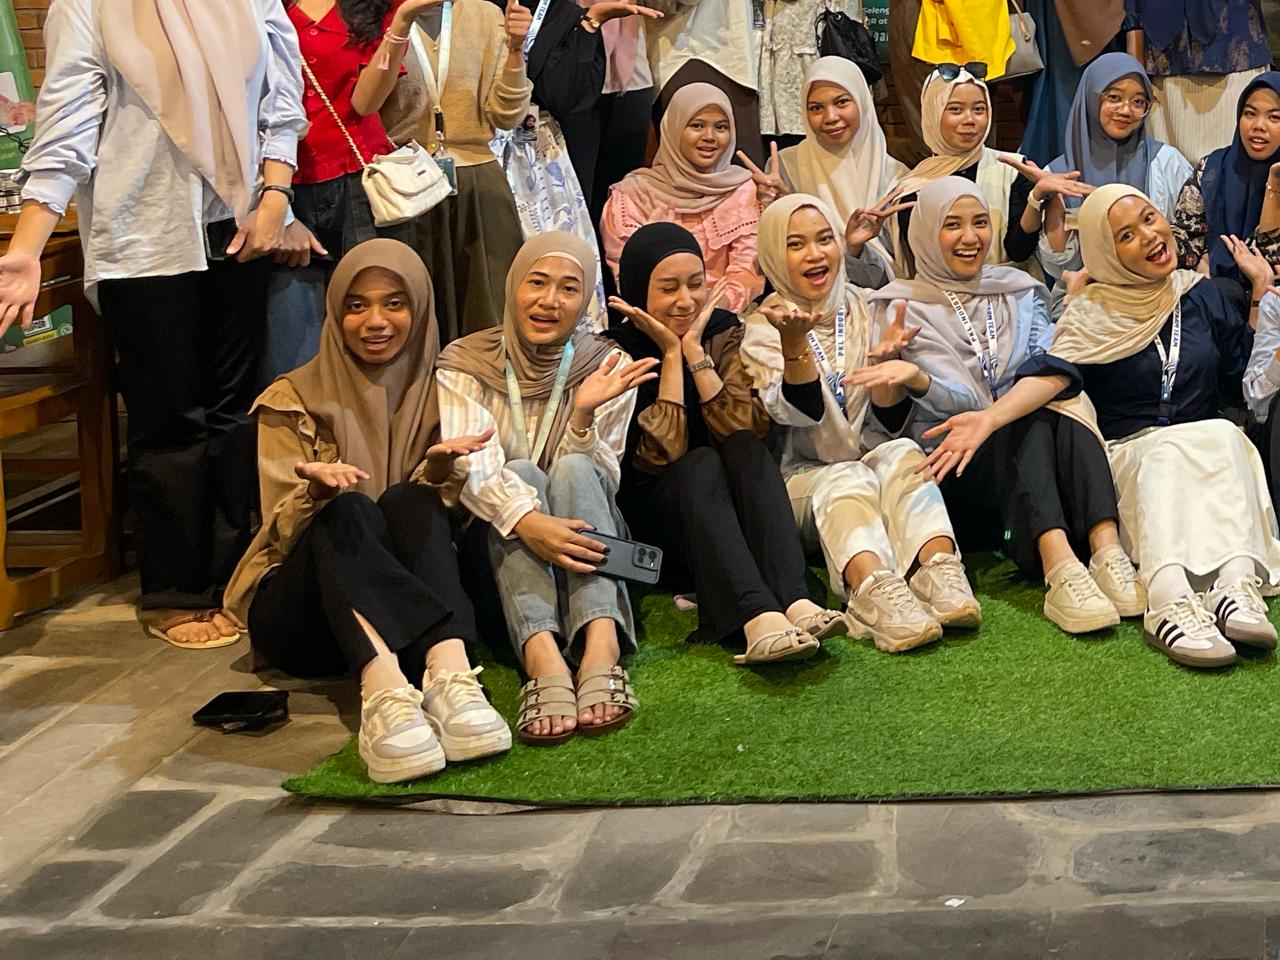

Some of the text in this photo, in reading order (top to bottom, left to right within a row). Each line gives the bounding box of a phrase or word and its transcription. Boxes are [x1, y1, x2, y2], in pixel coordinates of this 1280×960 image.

[967, 327, 977, 343] PKL
[987, 321, 995, 340] TEAM
[813, 342, 826, 362] TEAM
[837, 341, 845, 357] PKL
